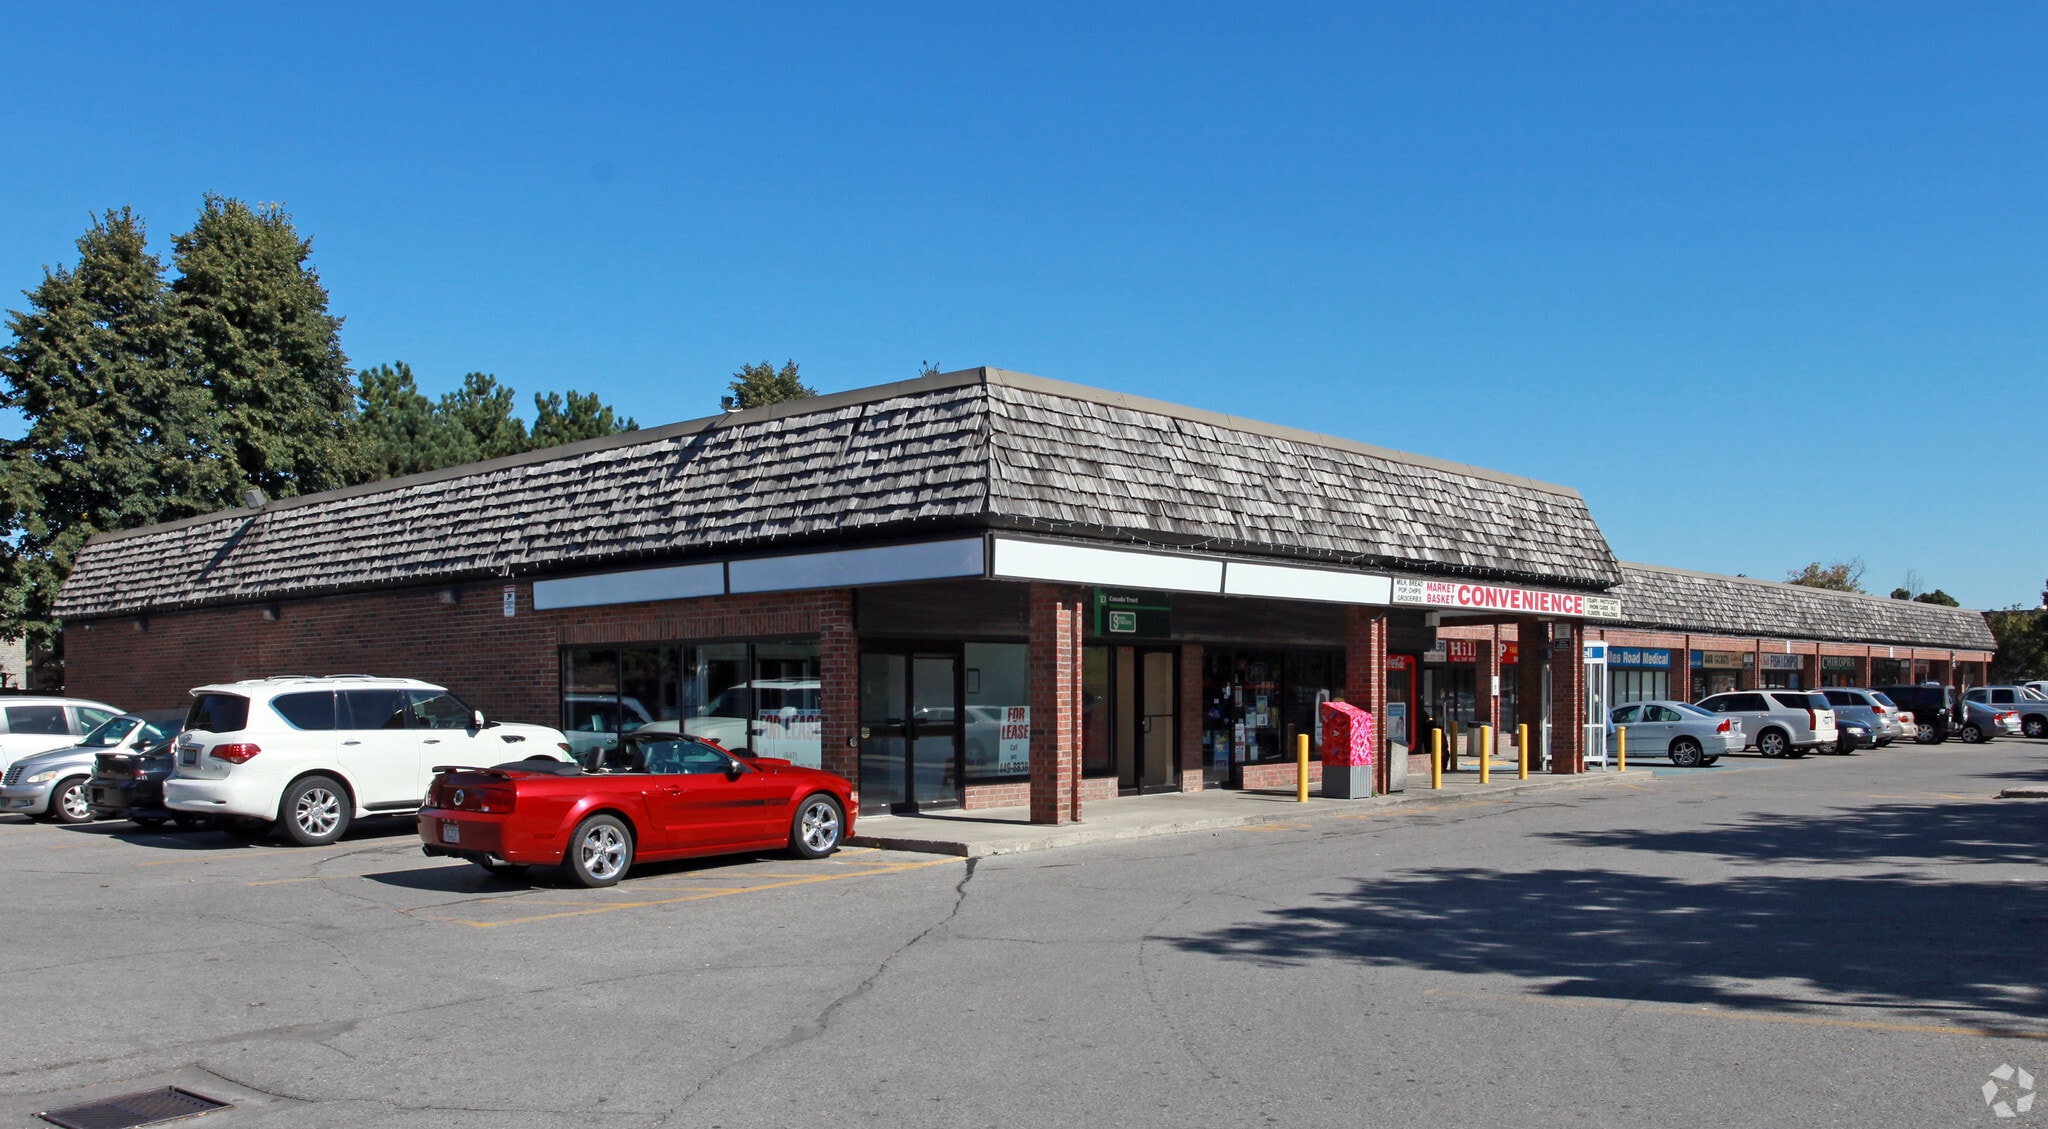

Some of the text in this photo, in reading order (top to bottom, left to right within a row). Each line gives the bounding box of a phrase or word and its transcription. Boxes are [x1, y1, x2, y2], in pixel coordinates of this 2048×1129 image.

[1427, 582, 1456, 594] MARKET
[1109, 595, 1126, 603] Canada
[1427, 593, 1455, 604] BASKET
[1458, 584, 1583, 615] CONVENIENCE
[1623, 651, 1641, 665] Road
[1642, 652, 1669, 665] Medical
[1821, 656, 1856, 670] CHIROPRA
[1007, 707, 1025, 722] FOR
[1001, 724, 1029, 740] LEASE
